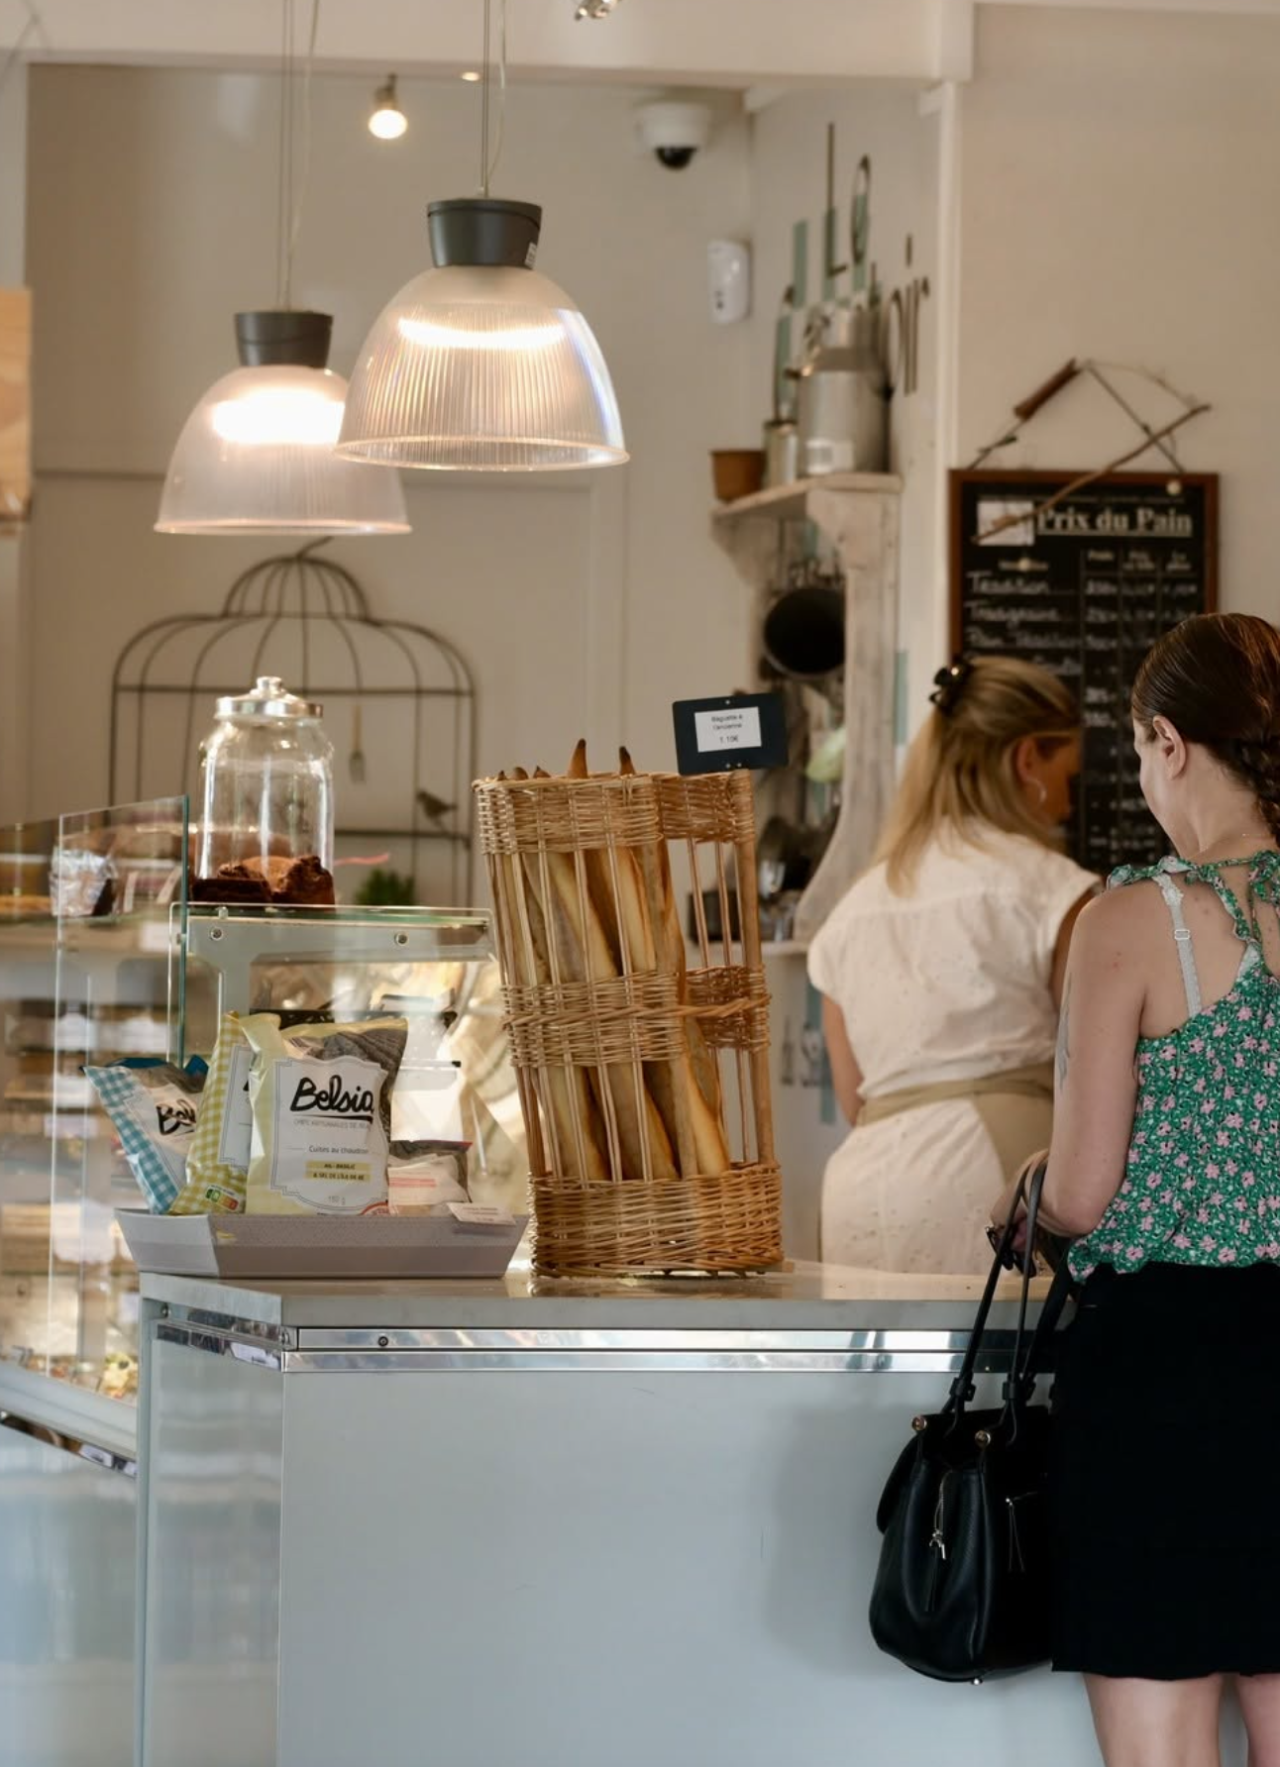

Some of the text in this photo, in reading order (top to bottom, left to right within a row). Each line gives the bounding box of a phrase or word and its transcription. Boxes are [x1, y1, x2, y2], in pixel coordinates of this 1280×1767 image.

[1036, 506, 1192, 534] Prix du Pain
[289, 1075, 375, 1114] Belsia
